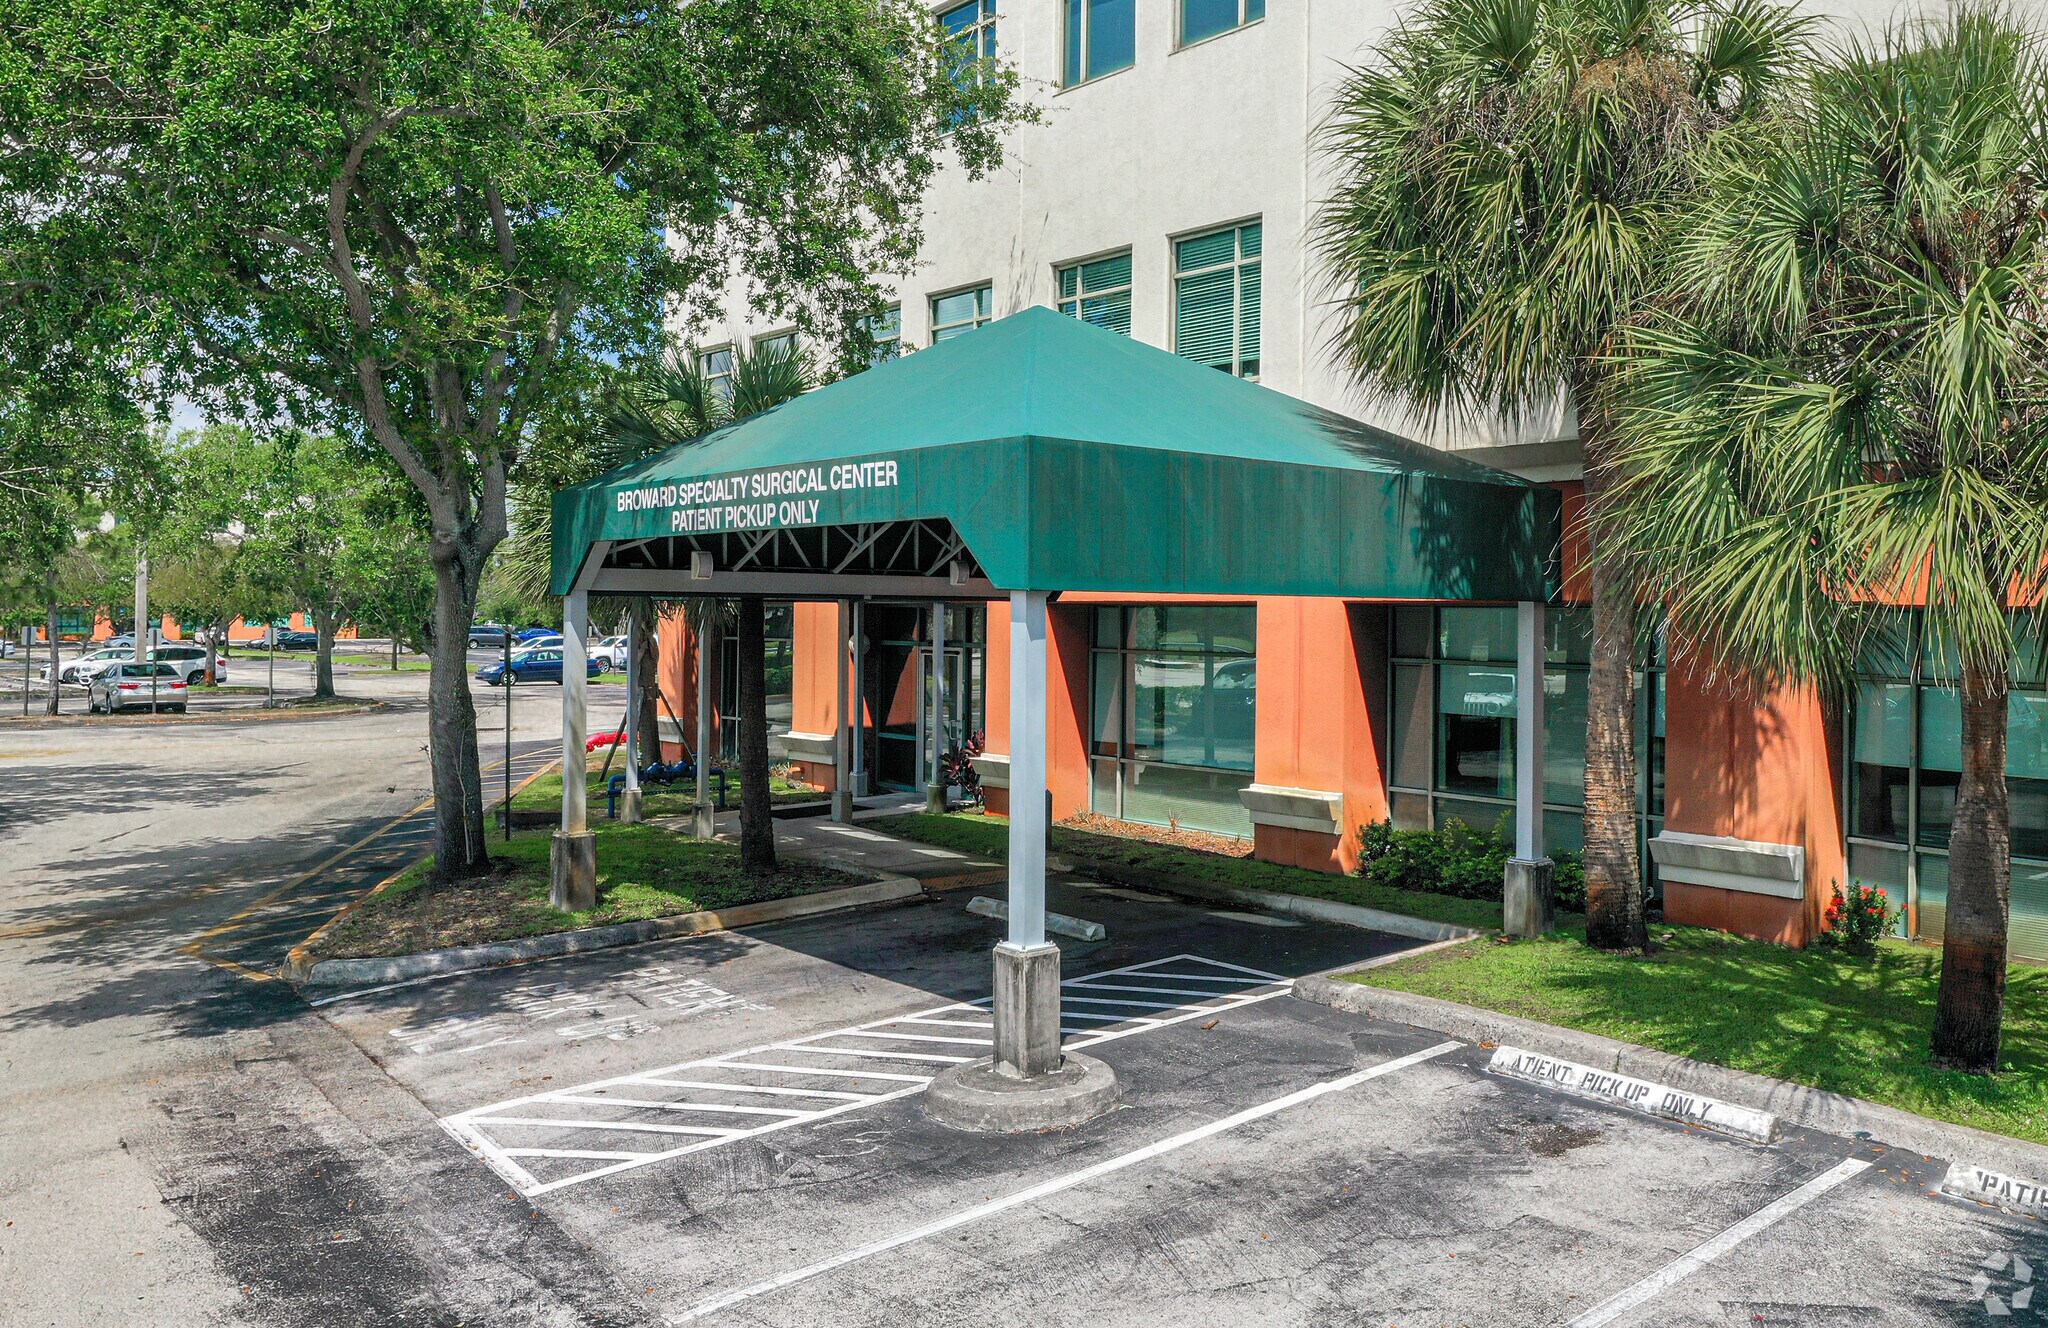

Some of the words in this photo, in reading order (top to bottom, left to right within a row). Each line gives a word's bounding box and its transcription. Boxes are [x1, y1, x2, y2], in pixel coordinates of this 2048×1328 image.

[617, 485, 677, 512] BROWARD
[679, 476, 748, 505] SPECIALTY
[751, 469, 827, 498] SURGICAL
[829, 460, 898, 491] CENTER
[672, 507, 722, 532] PATIENT
[725, 503, 776, 529] PICKUP
[779, 499, 819, 525] ONLY
[1504, 1054, 1572, 1082] ATIENT
[1661, 1092, 1713, 1120] ONLY
